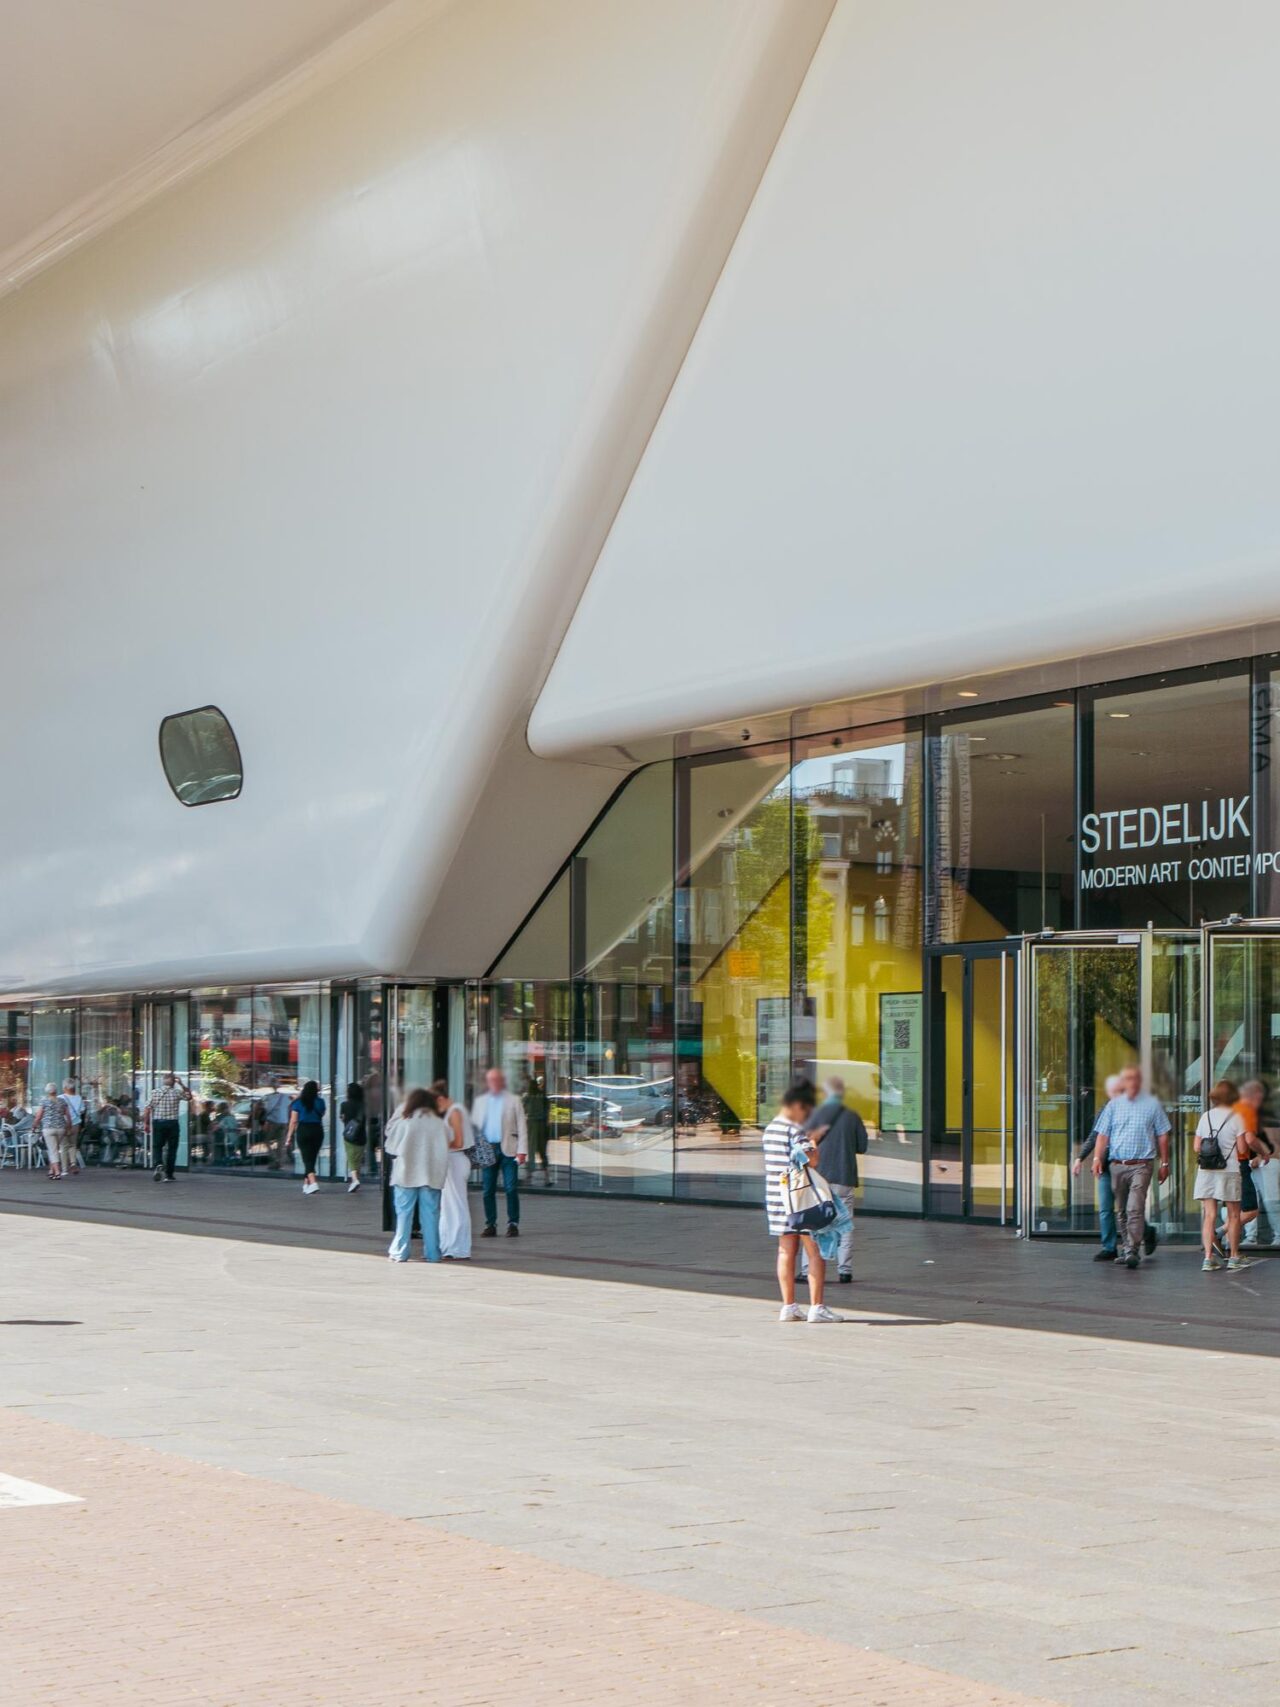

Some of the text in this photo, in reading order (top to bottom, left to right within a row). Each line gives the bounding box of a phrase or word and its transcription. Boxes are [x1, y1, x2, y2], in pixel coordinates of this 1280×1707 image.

[1081, 796, 1251, 853] STEDELIJK
[1081, 864, 1147, 889] MODERN
[1149, 861, 1182, 884] ART
